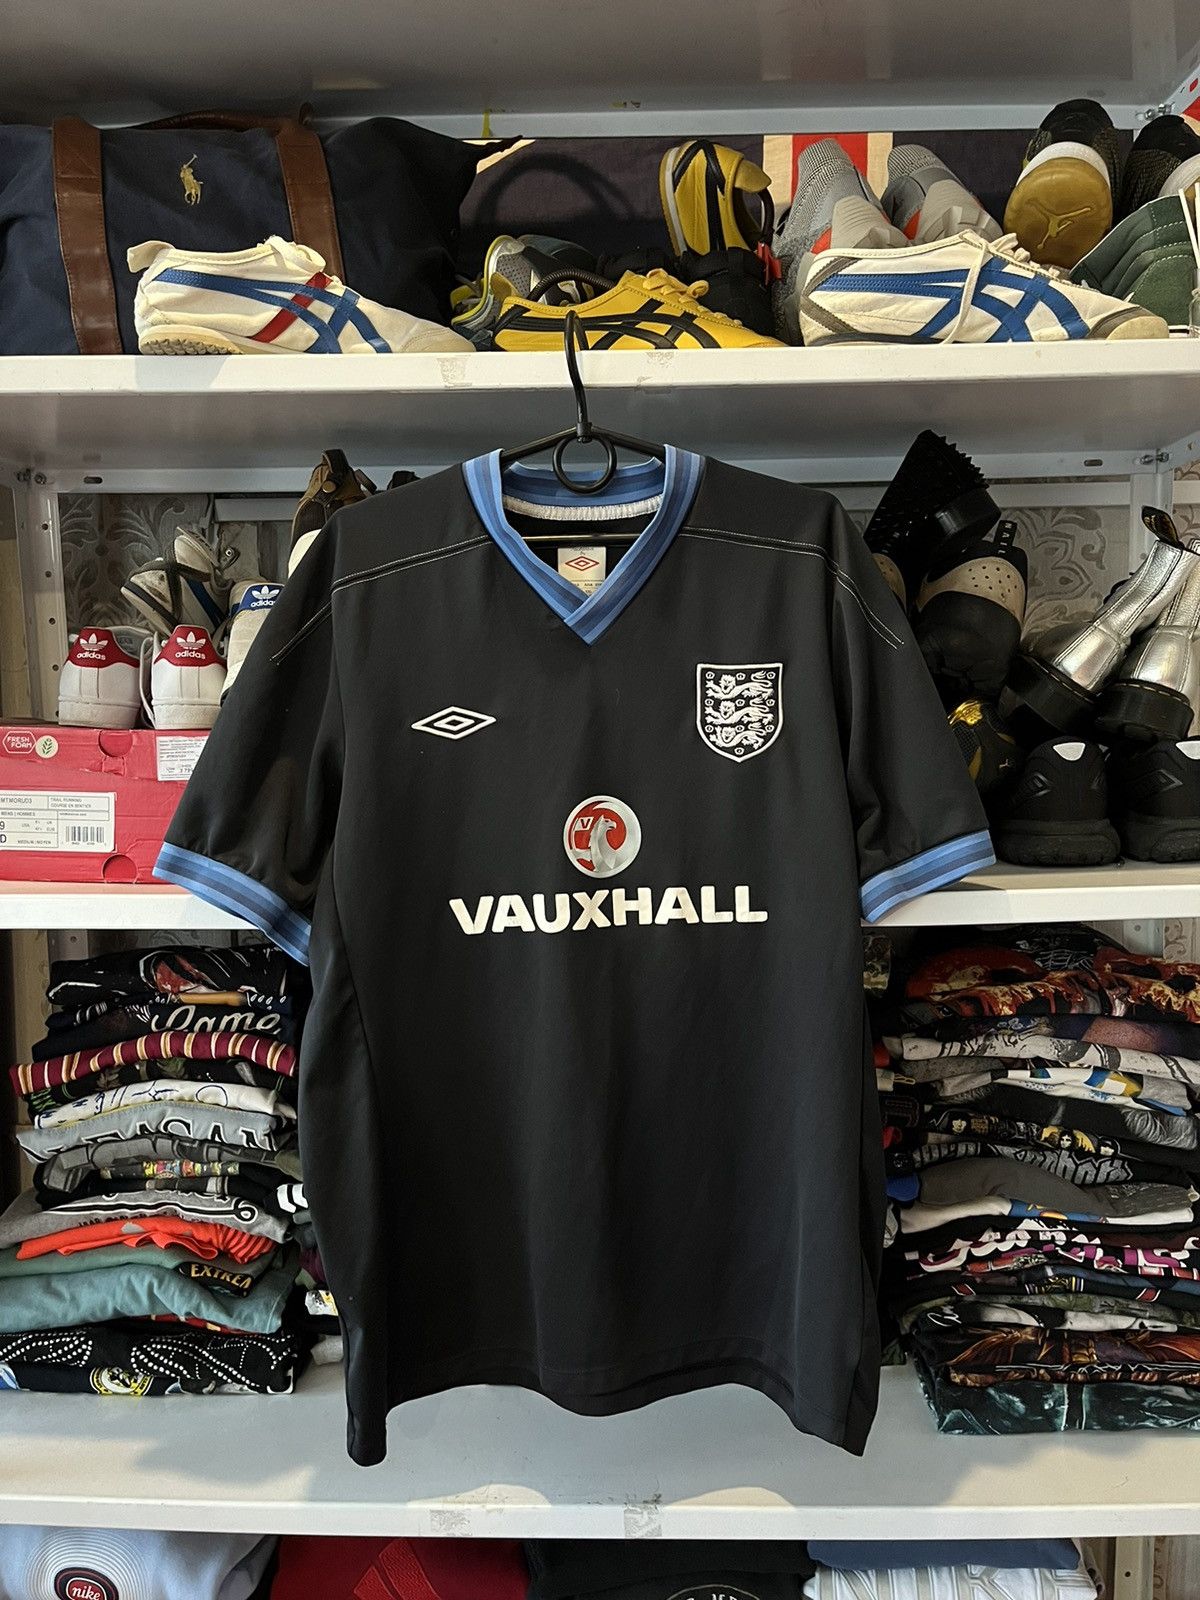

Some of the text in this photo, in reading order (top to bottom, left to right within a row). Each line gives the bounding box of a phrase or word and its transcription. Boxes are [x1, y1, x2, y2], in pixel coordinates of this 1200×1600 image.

[76, 651, 106, 661] adidas
[175, 650, 206, 660] adidas
[449, 885, 768, 935] VAUXHALL
[72, 1585, 101, 1600] nike
